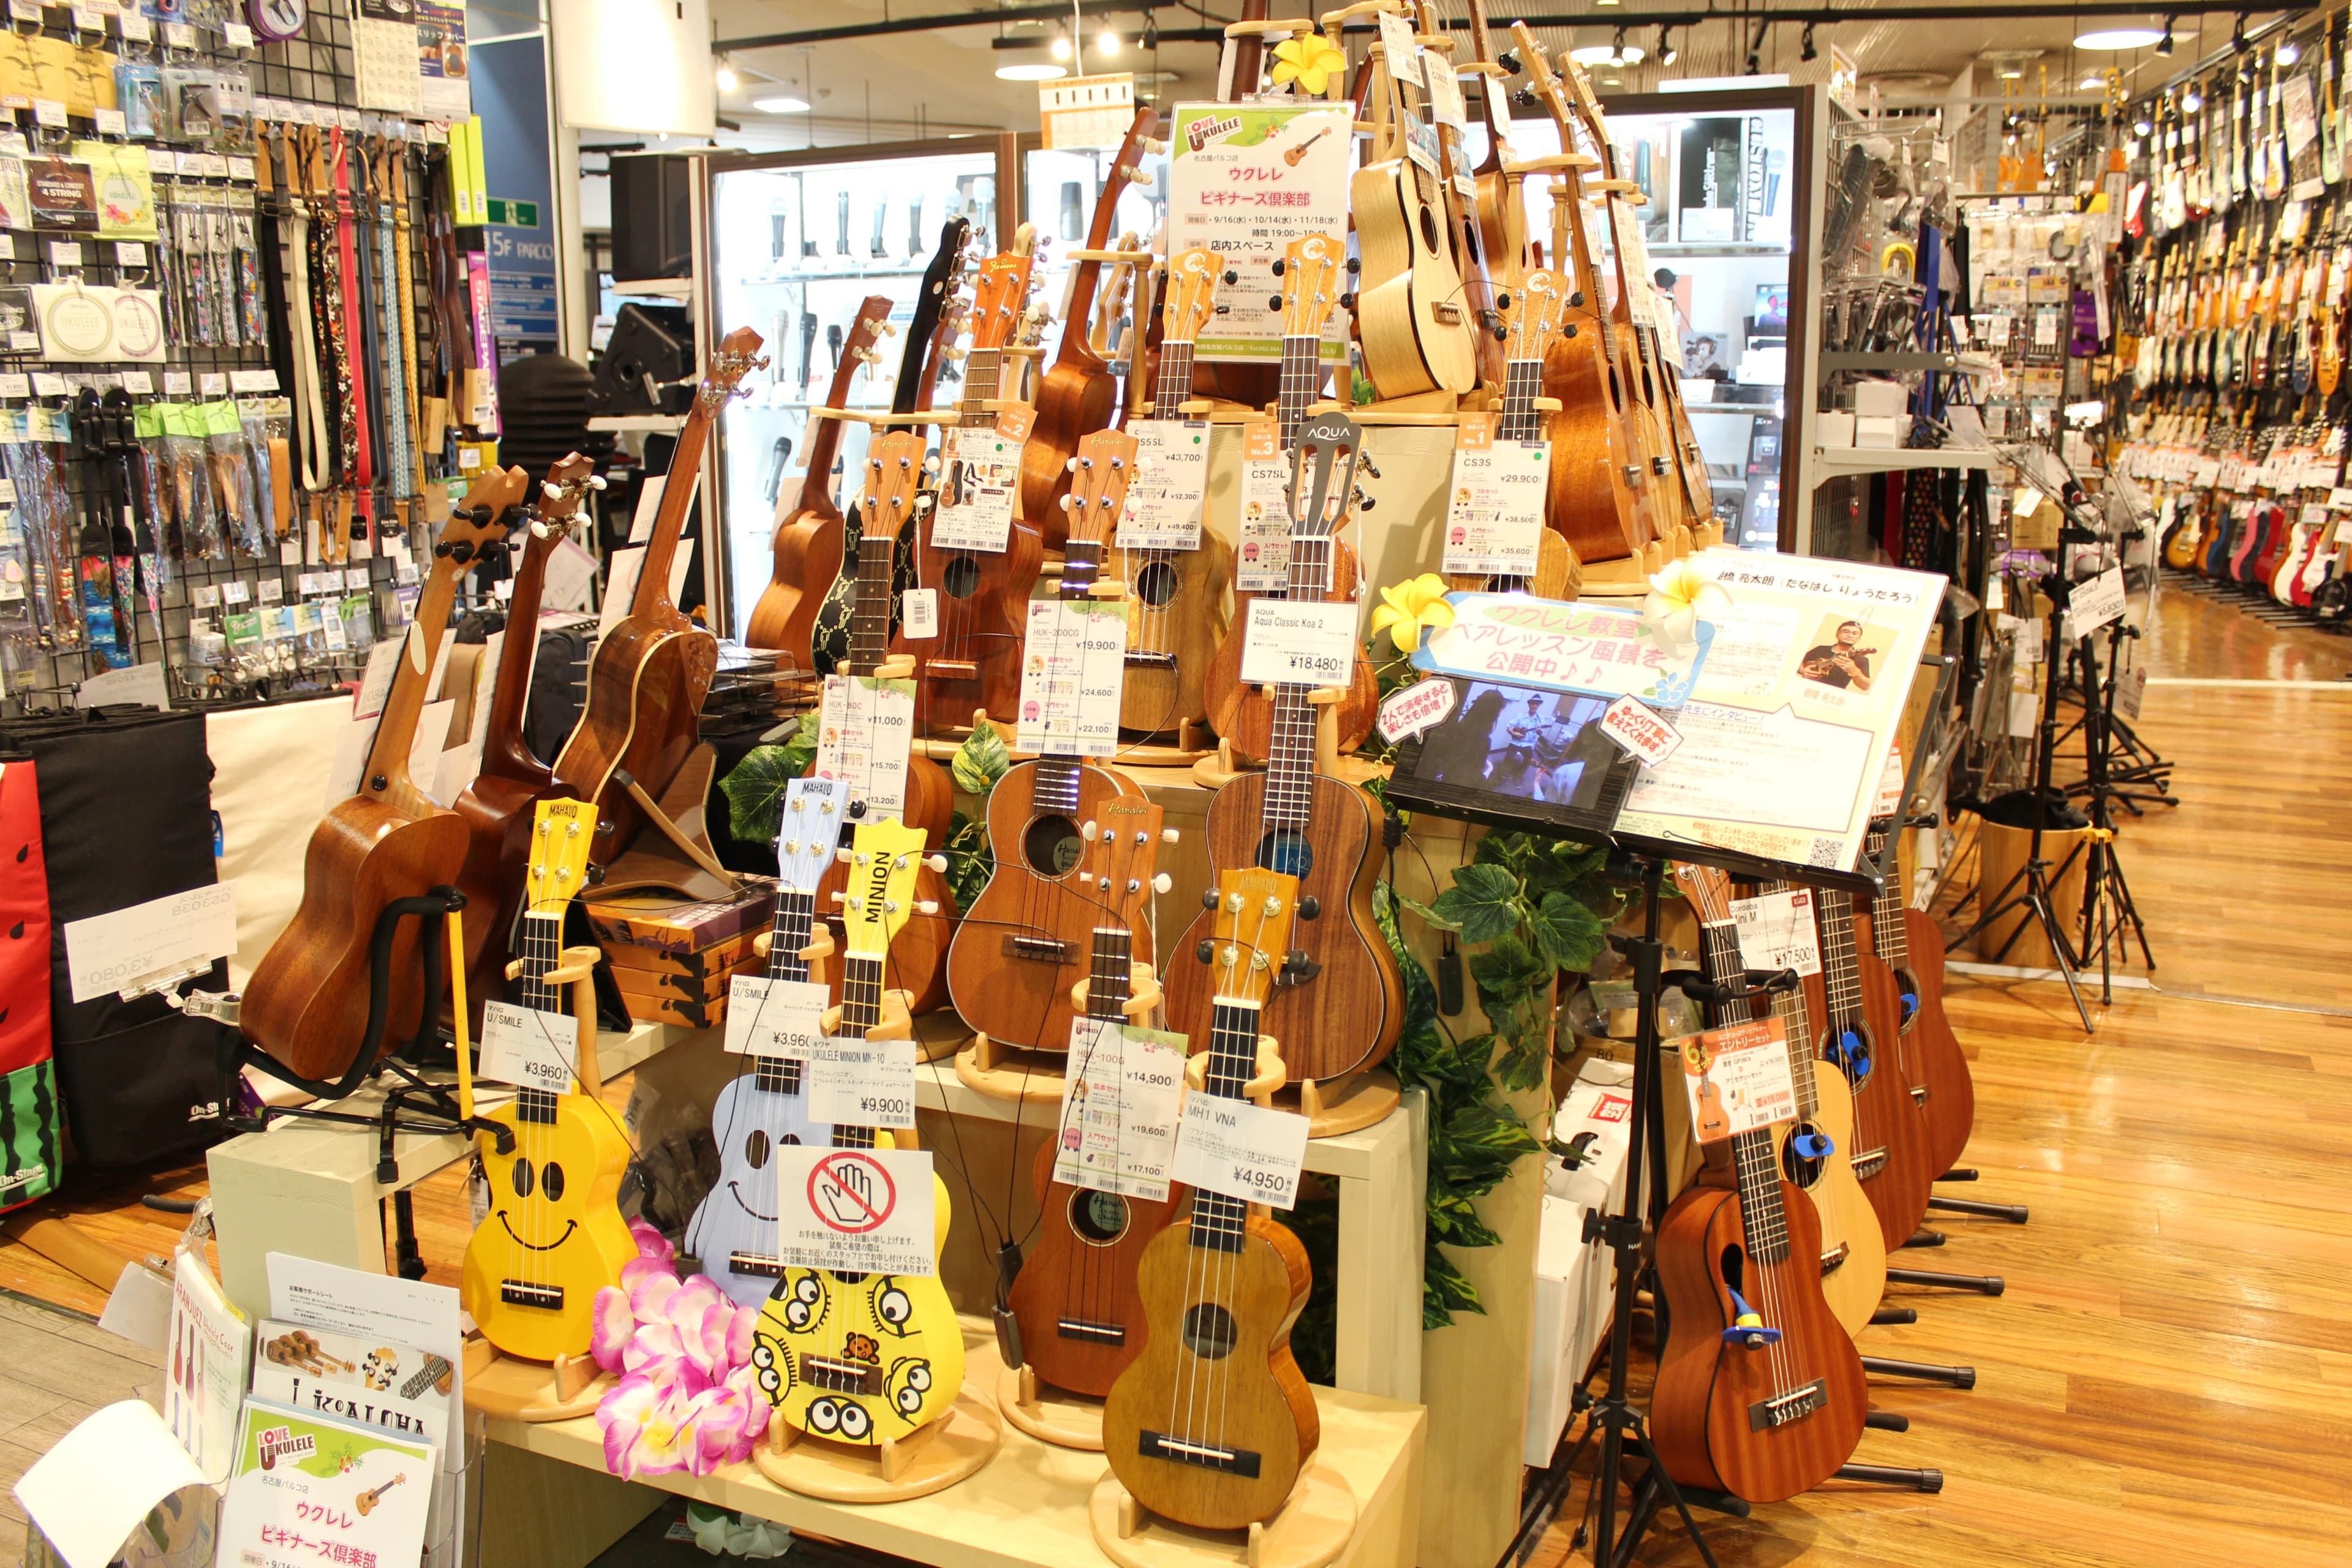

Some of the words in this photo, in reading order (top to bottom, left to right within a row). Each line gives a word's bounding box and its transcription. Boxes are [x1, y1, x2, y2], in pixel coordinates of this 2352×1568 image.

[1185, 116, 1216, 135] LOVE
[1188, 118, 1240, 152] UKULELE
[1194, 154, 1238, 163] 名古屋パルコ店
[1229, 167, 1284, 181] ウクレレ
[50, 189, 81, 198] STRING
[1200, 192, 1312, 207] ビギナーズ倶楽部
[518, 242, 554, 260] PARCO
[1211, 240, 1273, 251] 店内スペース
[60, 316, 99, 328] UKULELE
[475, 279, 491, 370] STAGEPA
[1002, 423, 1024, 437] No.2
[1307, 426, 1350, 441] AQUA
[881, 439, 912, 450] Hanalei
[1464, 431, 1484, 445] No.1
[1251, 442, 1274, 456] No.3
[1463, 458, 1491, 467] CS3S
[1252, 470, 1286, 479] CS7SL
[1501, 475, 1539, 483] ¥29,900
[1739, 571, 1775, 586] 亮太朗
[1254, 616, 1272, 627] Aqua
[1275, 617, 1299, 627] Classic
[1302, 618, 1316, 628] Koa
[1318, 619, 1324, 628] 2
[1495, 605, 1639, 639] ウクレレ教室
[1033, 628, 1079, 637] HUK-200CG
[1076, 641, 1115, 650] ¥19,900
[1454, 623, 1667, 669] ペアレッスン風景を
[1289, 655, 1338, 671] ¥18,480
[828, 701, 862, 710] HUK-80C
[1381, 684, 1449, 725] 2人で演奏すると
[867, 715, 903, 726] ¥11,000
[1620, 705, 1668, 745] ゆっくり丁寧に
[802, 781, 833, 796] MAHALO
[866, 796, 895, 805] ¥13,200
[548, 803, 578, 819] MAHALO
[1107, 802, 1148, 819] Hanalei
[865, 851, 891, 923] MINION
[1730, 902, 1758, 913] Cordoba
[1749, 911, 1757, 922] M
[1774, 947, 1811, 967] ¥17,500
[733, 987, 769, 1001] U/SMILE
[487, 1012, 523, 1028] U/SMILE
[1720, 1034, 1771, 1052] エントリーセット
[813, 1050, 839, 1061] UKULELE
[839, 1050, 861, 1063] MINION
[862, 1052, 886, 1064] MN-10
[1077, 1049, 1125, 1066] HUK-100G
[524, 1060, 562, 1080] ¥3,960
[1126, 1070, 1172, 1087] ¥14,900
[1092, 1082, 1123, 1094] 基本セット
[860, 1097, 904, 1114] ¥9,900
[1189, 1096, 1209, 1106] マハロ
[1188, 1104, 1210, 1121] MH1
[1215, 1111, 1236, 1128] VNA
[1087, 1131, 1118, 1142] 入門セット
[1131, 1125, 1166, 1137] ¥19,600
[0, 1162, 44, 1186] On-Stage
[1127, 1164, 1161, 1176] ¥17,100
[1233, 1166, 1284, 1191] ¥4,950
[798, 1230, 915, 1246] お手を触れないようお願い申し上げます。
[829, 1243, 883, 1253] 試奏ご希望の際は、
[290, 1285, 333, 1299] お客様サポートシート
[258, 1427, 290, 1446] LOVE
[260, 1434, 314, 1471] UKULELE
[261, 1475, 310, 1494] 名古屋パルコ店
[295, 1501, 354, 1530] ウクレレ
[260, 1524, 377, 1568] ビギナーズ倶楽部
